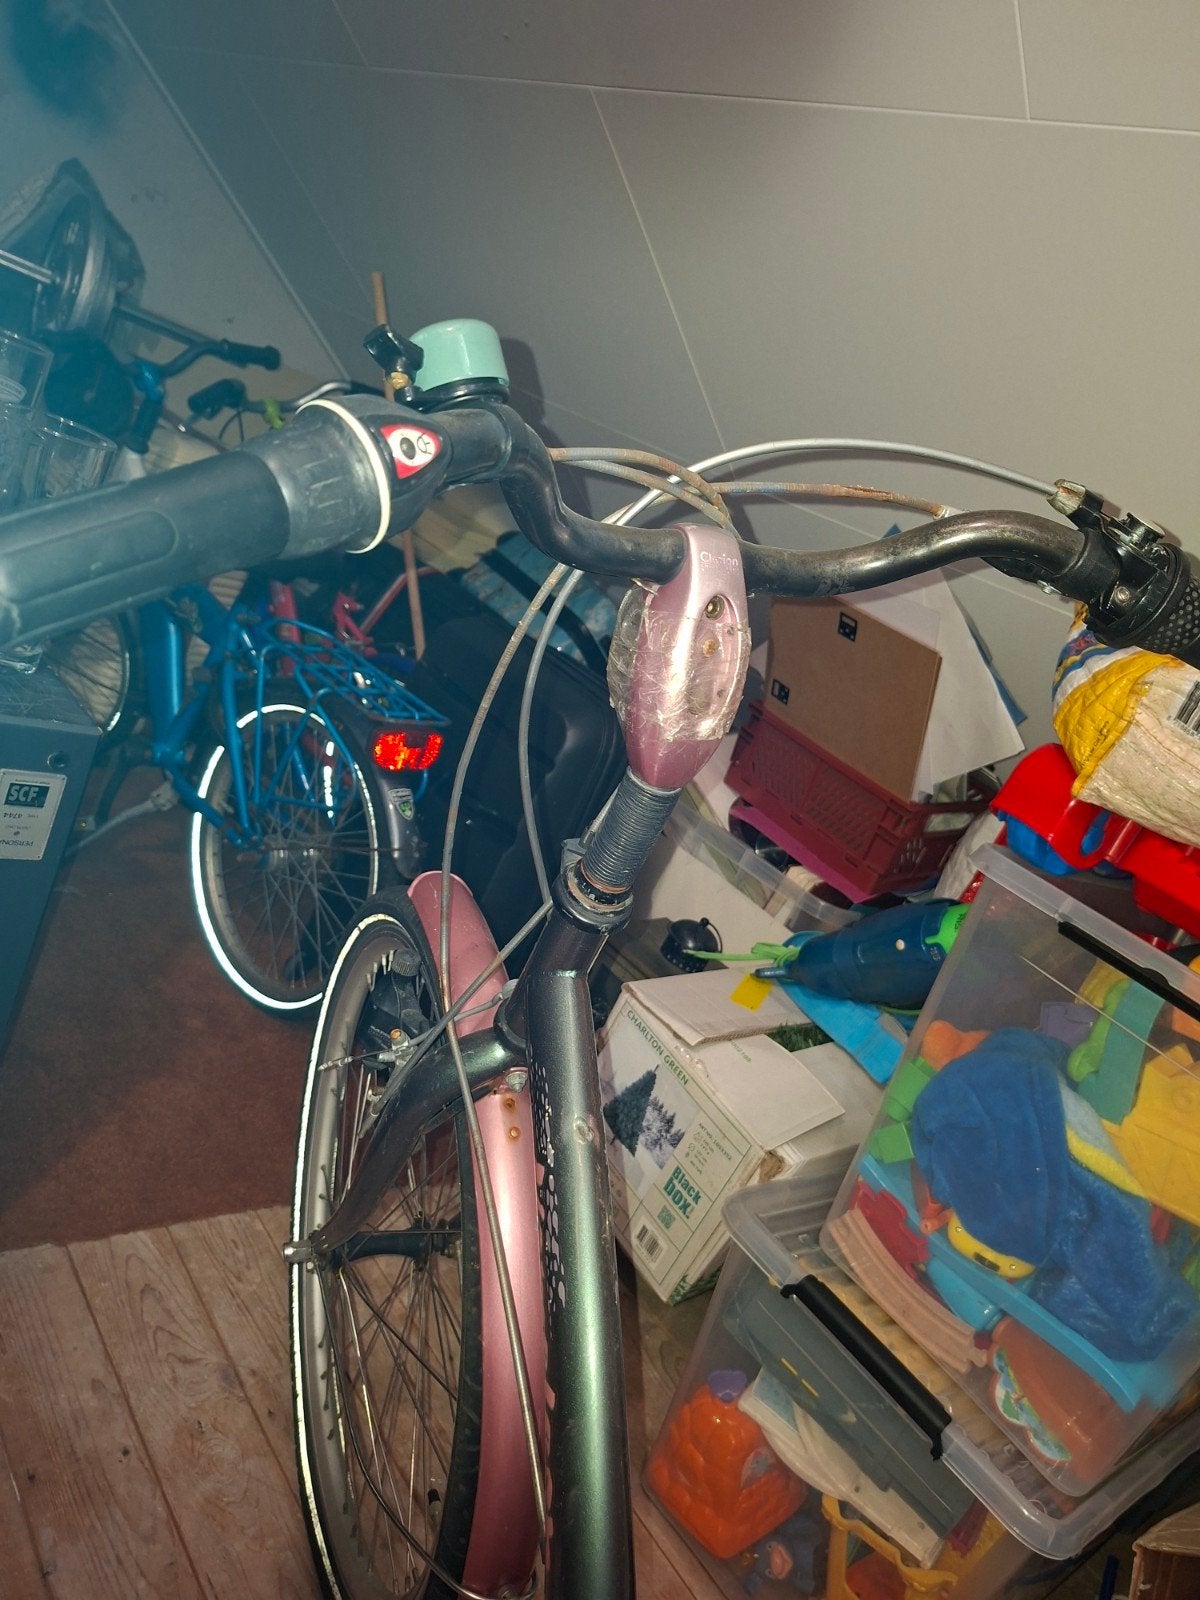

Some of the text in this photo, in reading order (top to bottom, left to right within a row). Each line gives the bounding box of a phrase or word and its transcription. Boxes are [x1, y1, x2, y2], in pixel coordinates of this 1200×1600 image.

[8, 785, 39, 802] SCF
[627, 1009, 689, 1086] CHARLTON GREEN
[672, 1165, 702, 1205] Black
